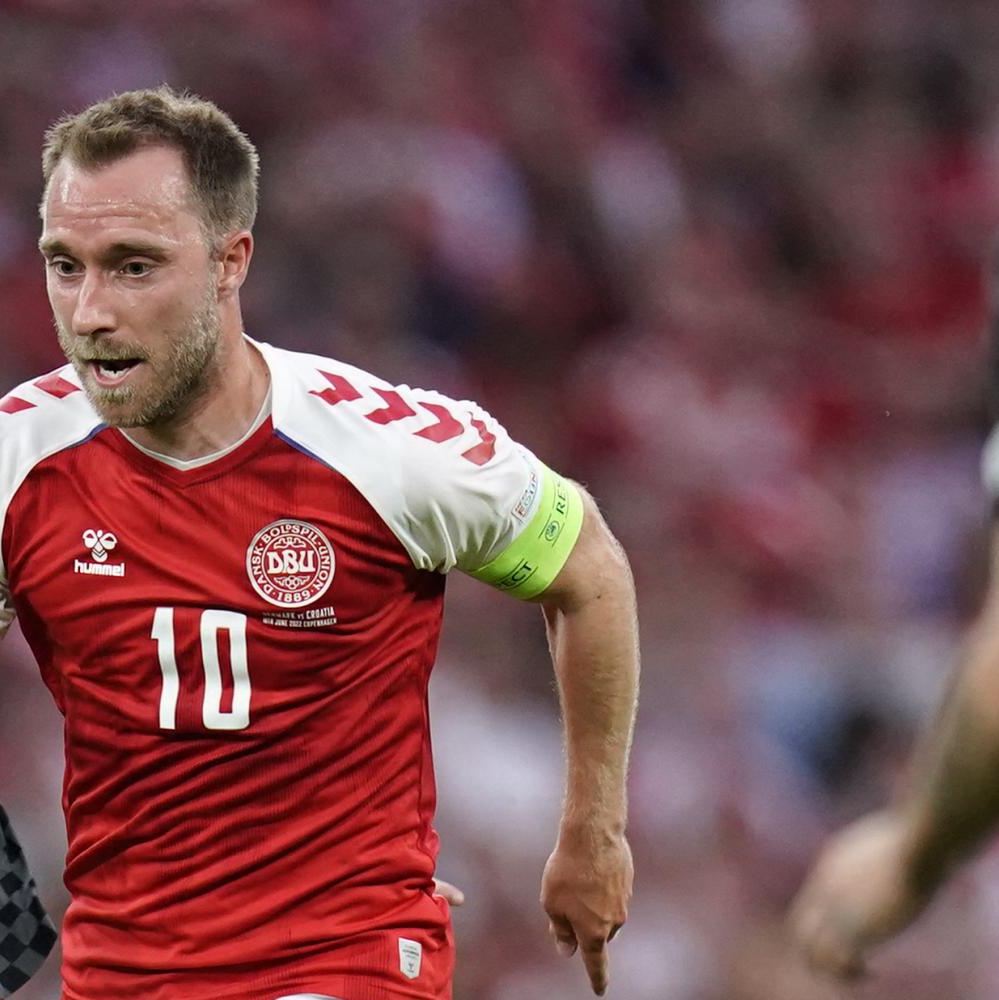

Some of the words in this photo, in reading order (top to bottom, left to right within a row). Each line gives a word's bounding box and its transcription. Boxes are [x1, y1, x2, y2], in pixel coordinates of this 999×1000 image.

[73, 558, 125, 577] hummel
[252, 546, 274, 595] DANSK
[267, 550, 316, 574] DBU
[314, 546, 331, 592] UNION
[278, 590, 311, 602] 1889
[275, 618, 288, 627] JUNE
[289, 620, 303, 628] 2022
[306, 606, 335, 619] CROATIA
[150, 607, 252, 730] 10
